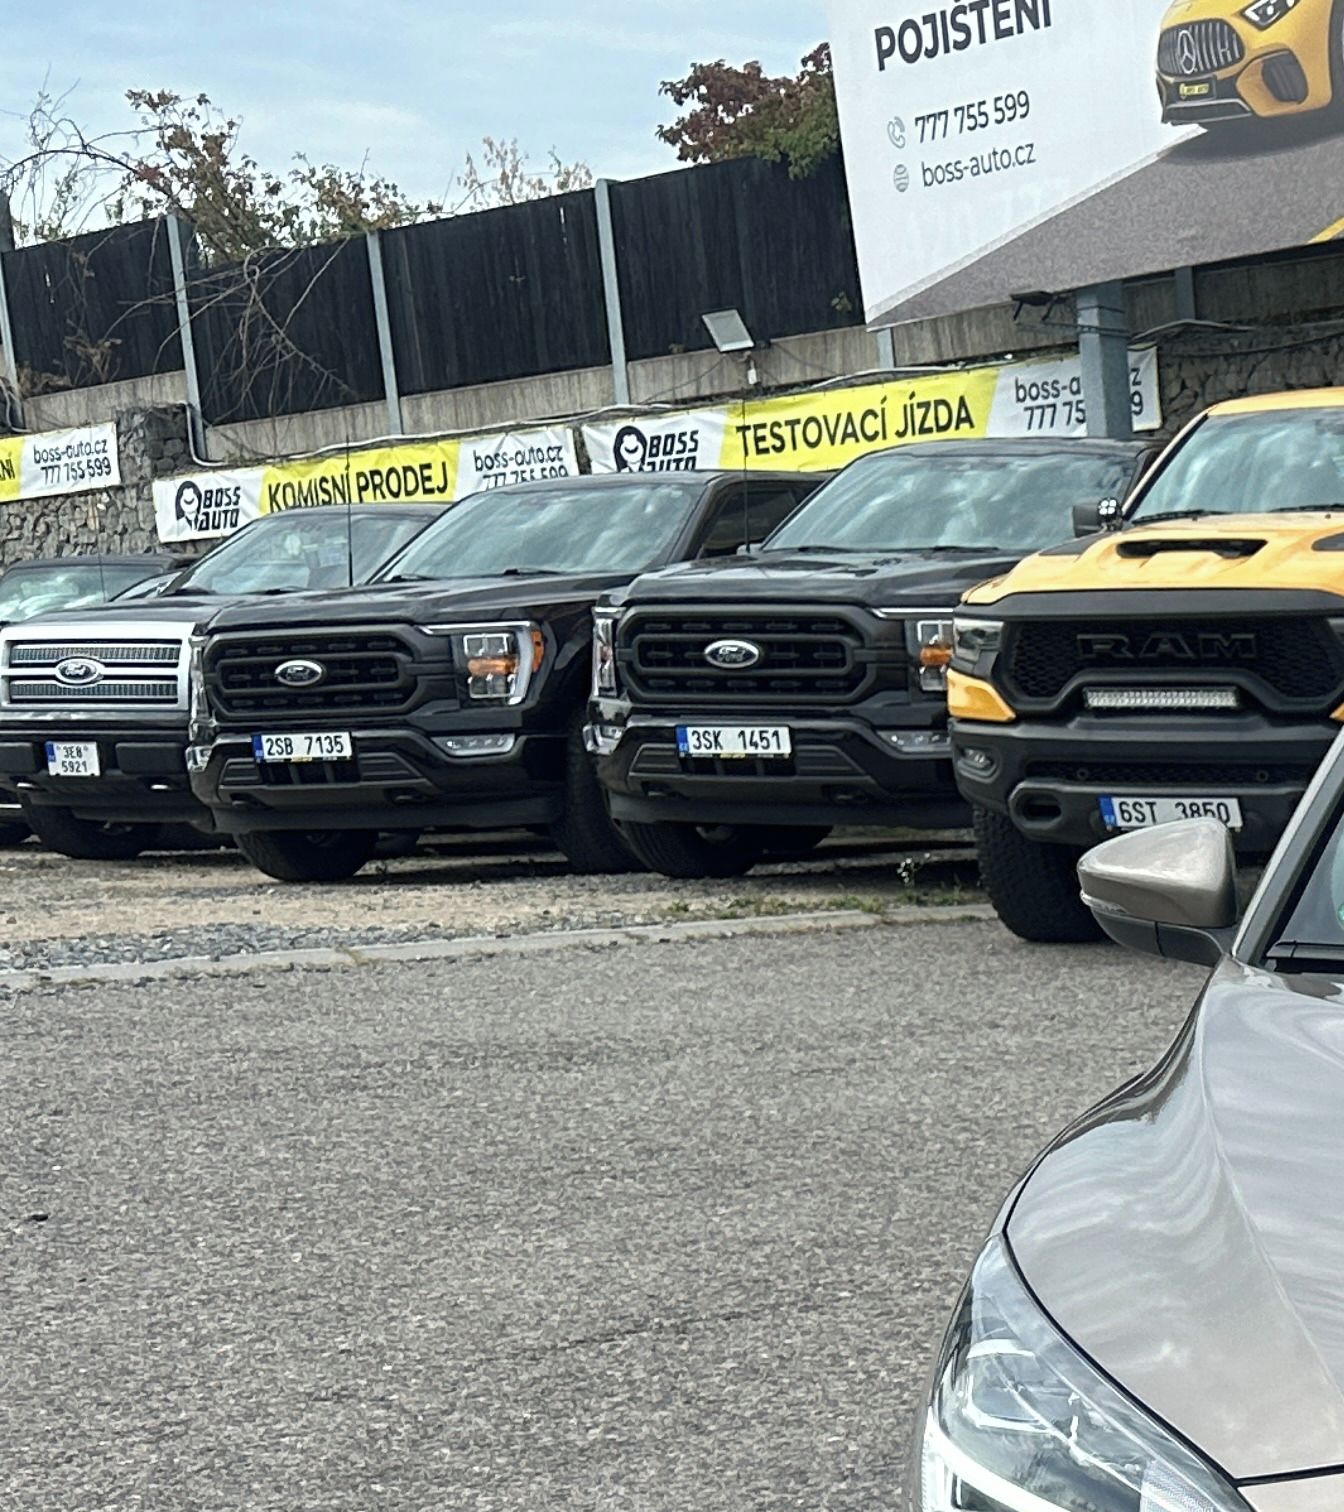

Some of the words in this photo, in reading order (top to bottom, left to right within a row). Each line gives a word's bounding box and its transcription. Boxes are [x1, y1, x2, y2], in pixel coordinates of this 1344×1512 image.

[914, 109, 949, 143] 777
[954, 99, 989, 134] 755
[993, 90, 1030, 125] 599
[921, 142, 1037, 188] boss-auto.cz
[735, 395, 888, 457] TESTOVACÍ
[895, 391, 975, 438] JÍZDA
[1023, 403, 1057, 430] 777
[33, 438, 108, 464] boss-auto.cz
[648, 429, 699, 459] BOSS
[40, 464, 60, 484] 777
[63, 460, 85, 481] 755
[87, 456, 112, 477] 599
[473, 445, 563, 472] boss-auto.cz
[356, 461, 448, 504] PRODEJ
[202, 485, 241, 510] BOSS
[197, 508, 240, 532] AUTO
[1076, 632, 1256, 660] RAM
[265, 737, 294, 756] 2SB
[303, 735, 345, 755] 7135
[691, 730, 724, 751] 3SK
[738, 729, 781, 751] 1451
[61, 760, 88, 773] 5921
[1118, 801, 1158, 825] 6ST
